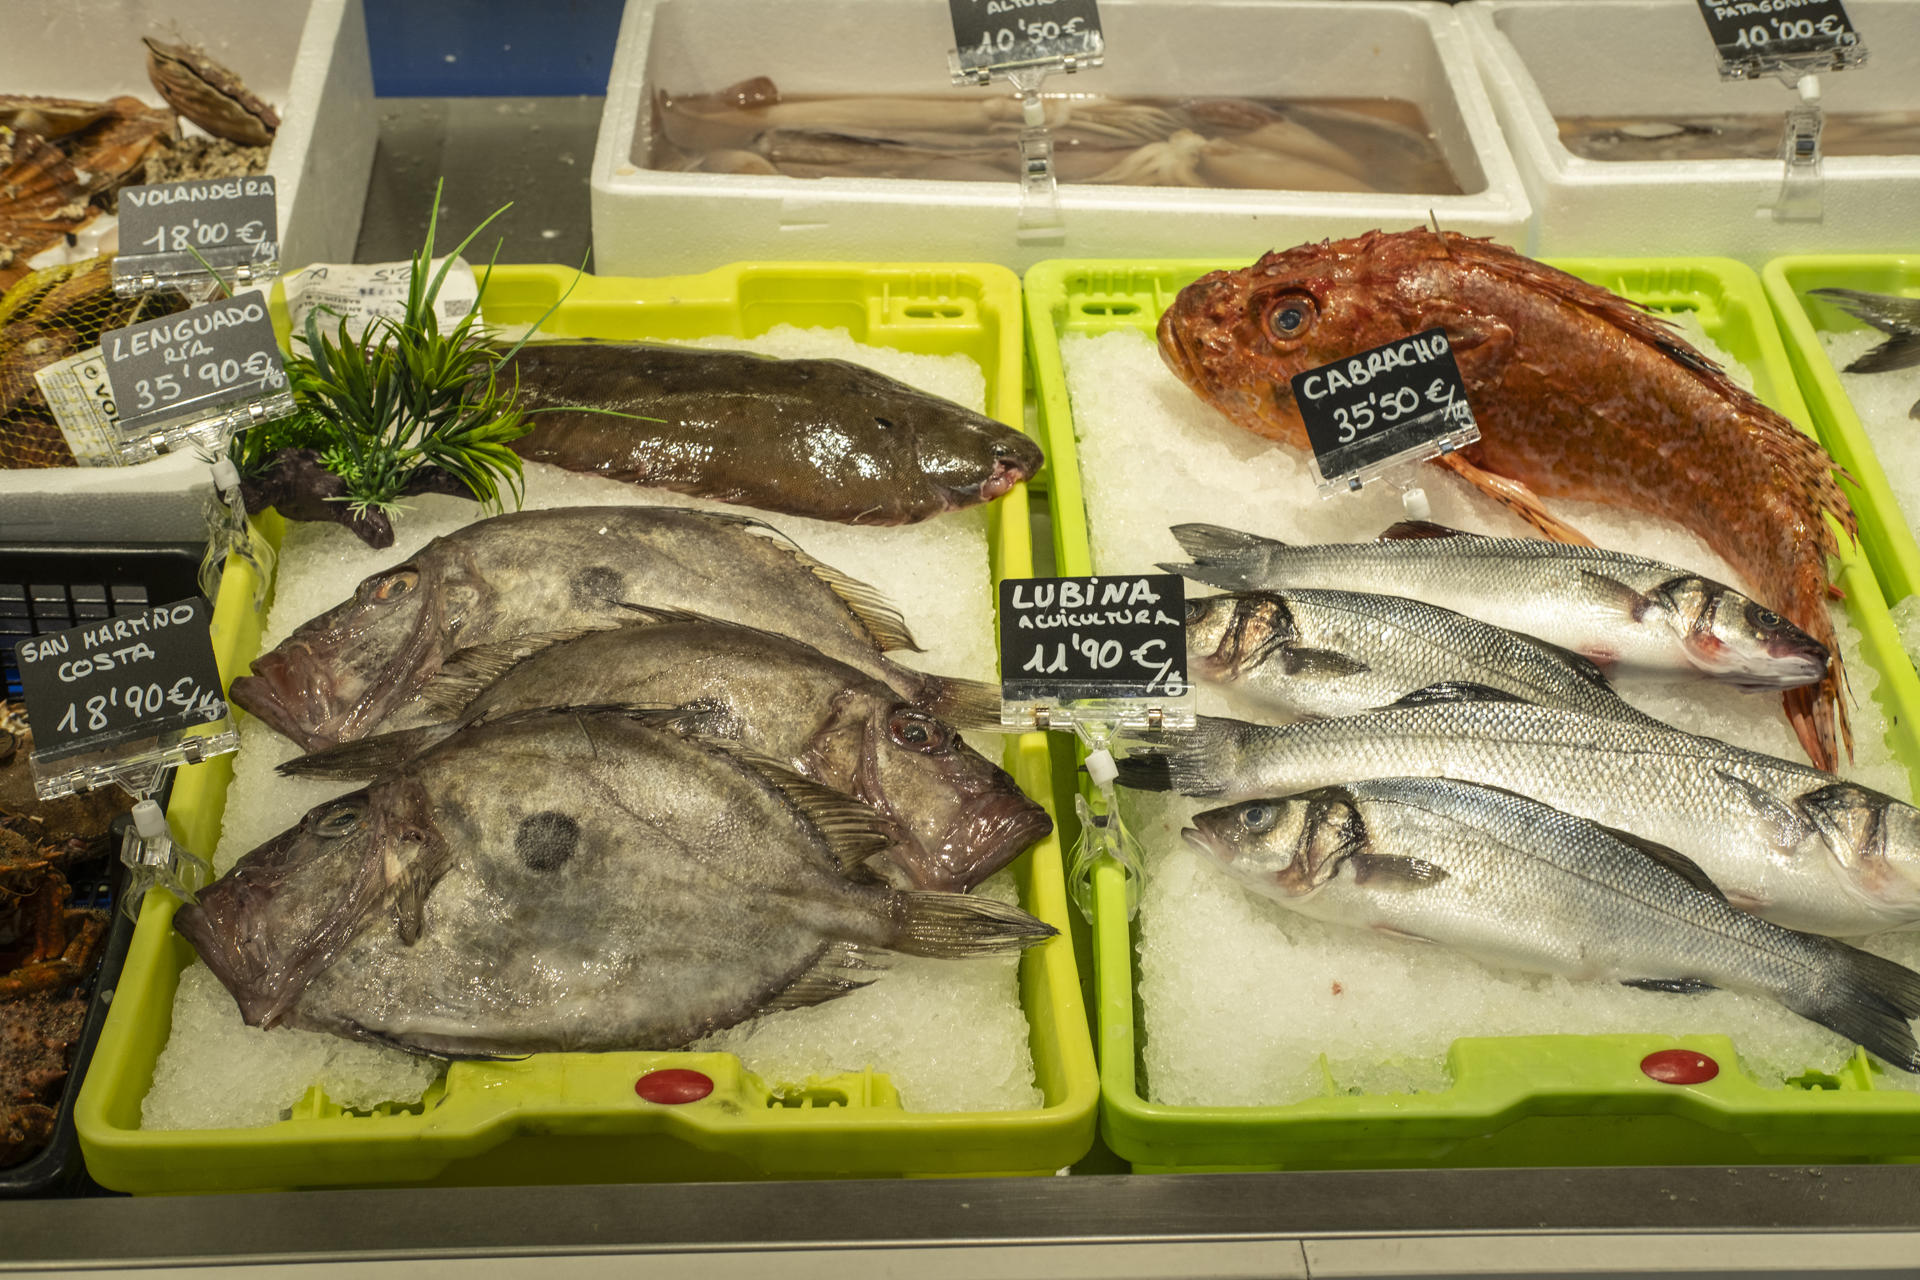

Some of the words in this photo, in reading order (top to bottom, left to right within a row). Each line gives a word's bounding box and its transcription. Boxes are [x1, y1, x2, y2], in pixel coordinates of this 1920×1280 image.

[976, 18, 1060, 54] 10'50
[1735, 17, 1814, 49] 10'00
[126, 178, 274, 208] VOLANDEIRA
[142, 218, 229, 252] 18'00
[112, 304, 264, 362] LENGUADO
[163, 339, 214, 365] RÍA
[134, 358, 240, 409] 35'90
[1303, 335, 1449, 399] CABRACHO
[1333, 386, 1420, 443] 35'50
[1012, 577, 1161, 609] LUBINA
[21, 634, 70, 663] SAN
[83, 605, 194, 649] MARTIÑO
[1018, 608, 1180, 630] ACUICULTURA
[58, 642, 155, 683] COSTA
[1022, 632, 1123, 673] 11'90
[56, 683, 163, 733] 18'90
